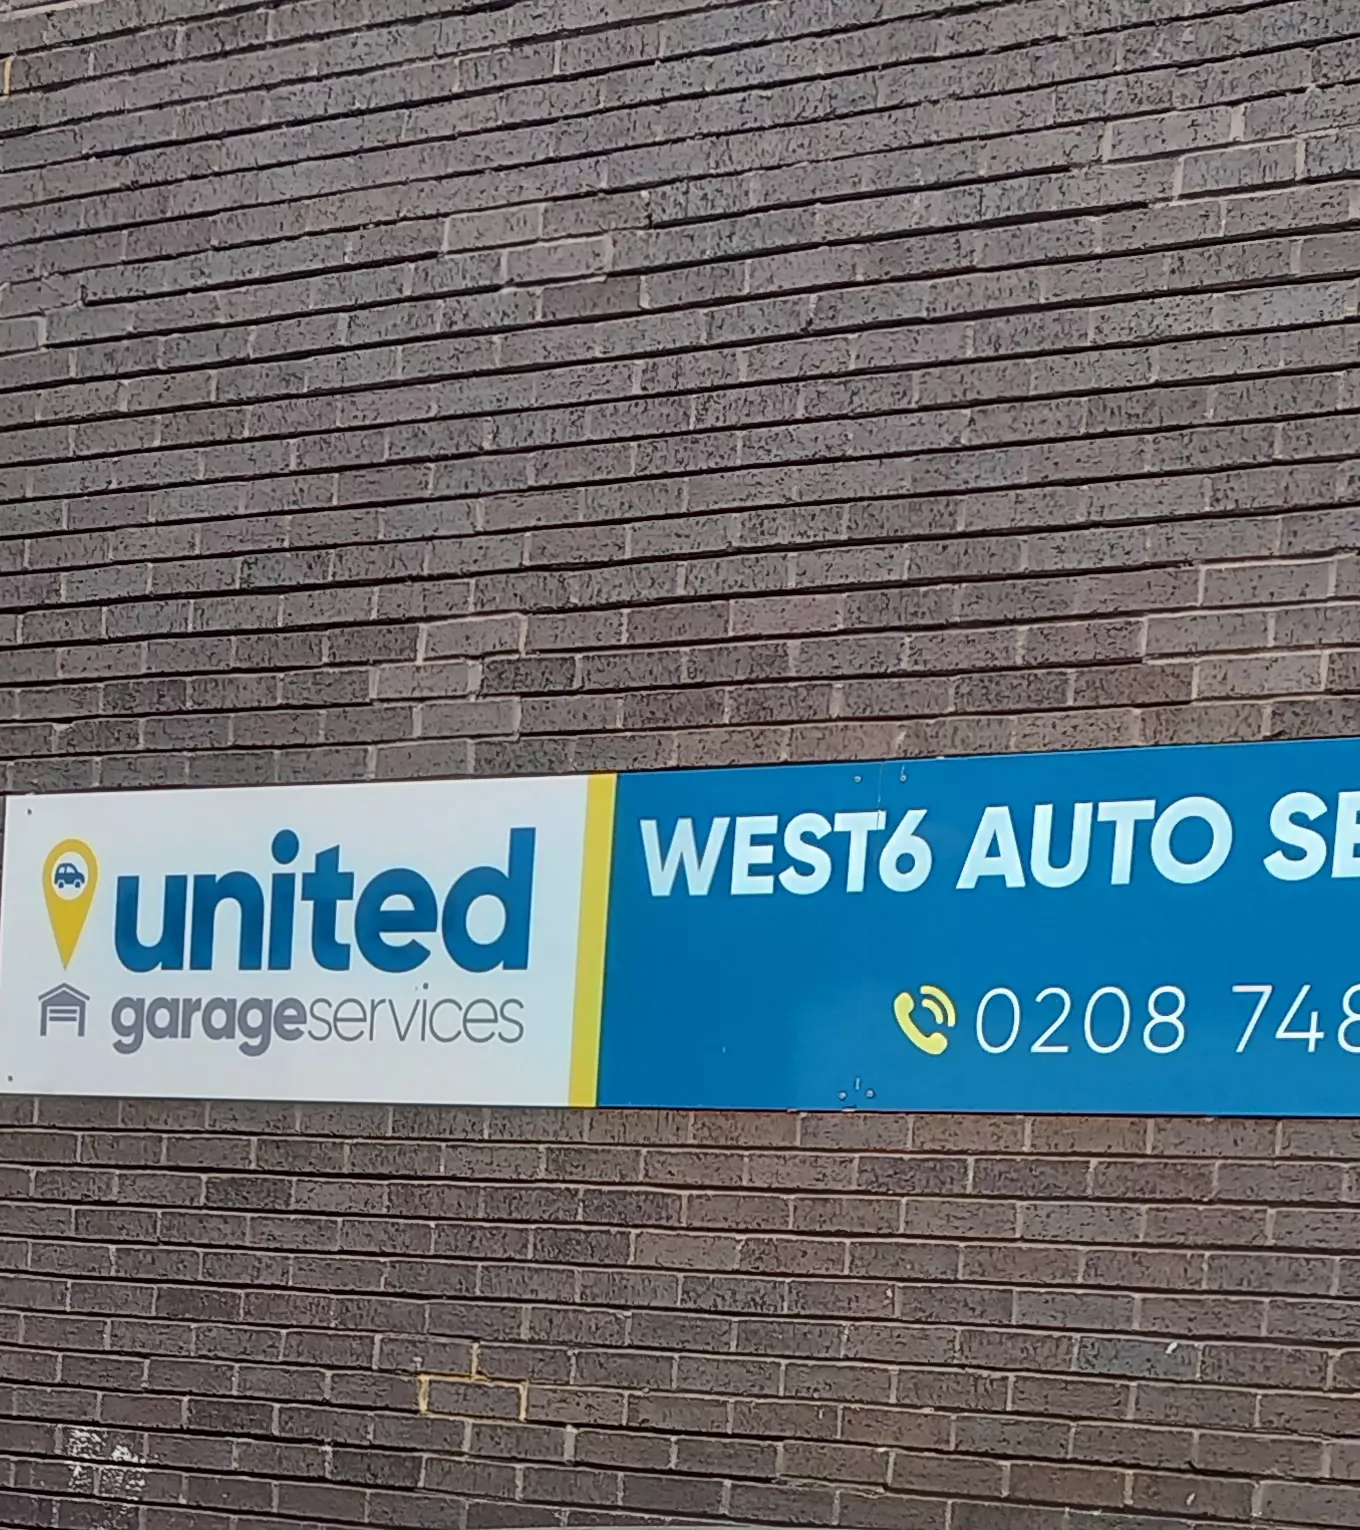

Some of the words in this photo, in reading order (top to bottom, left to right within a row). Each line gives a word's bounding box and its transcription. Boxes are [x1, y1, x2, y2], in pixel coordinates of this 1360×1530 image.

[640, 807, 933, 897] WEST6
[955, 796, 1233, 889] AUTO
[114, 827, 536, 974] united
[975, 985, 1186, 1054] 0208
